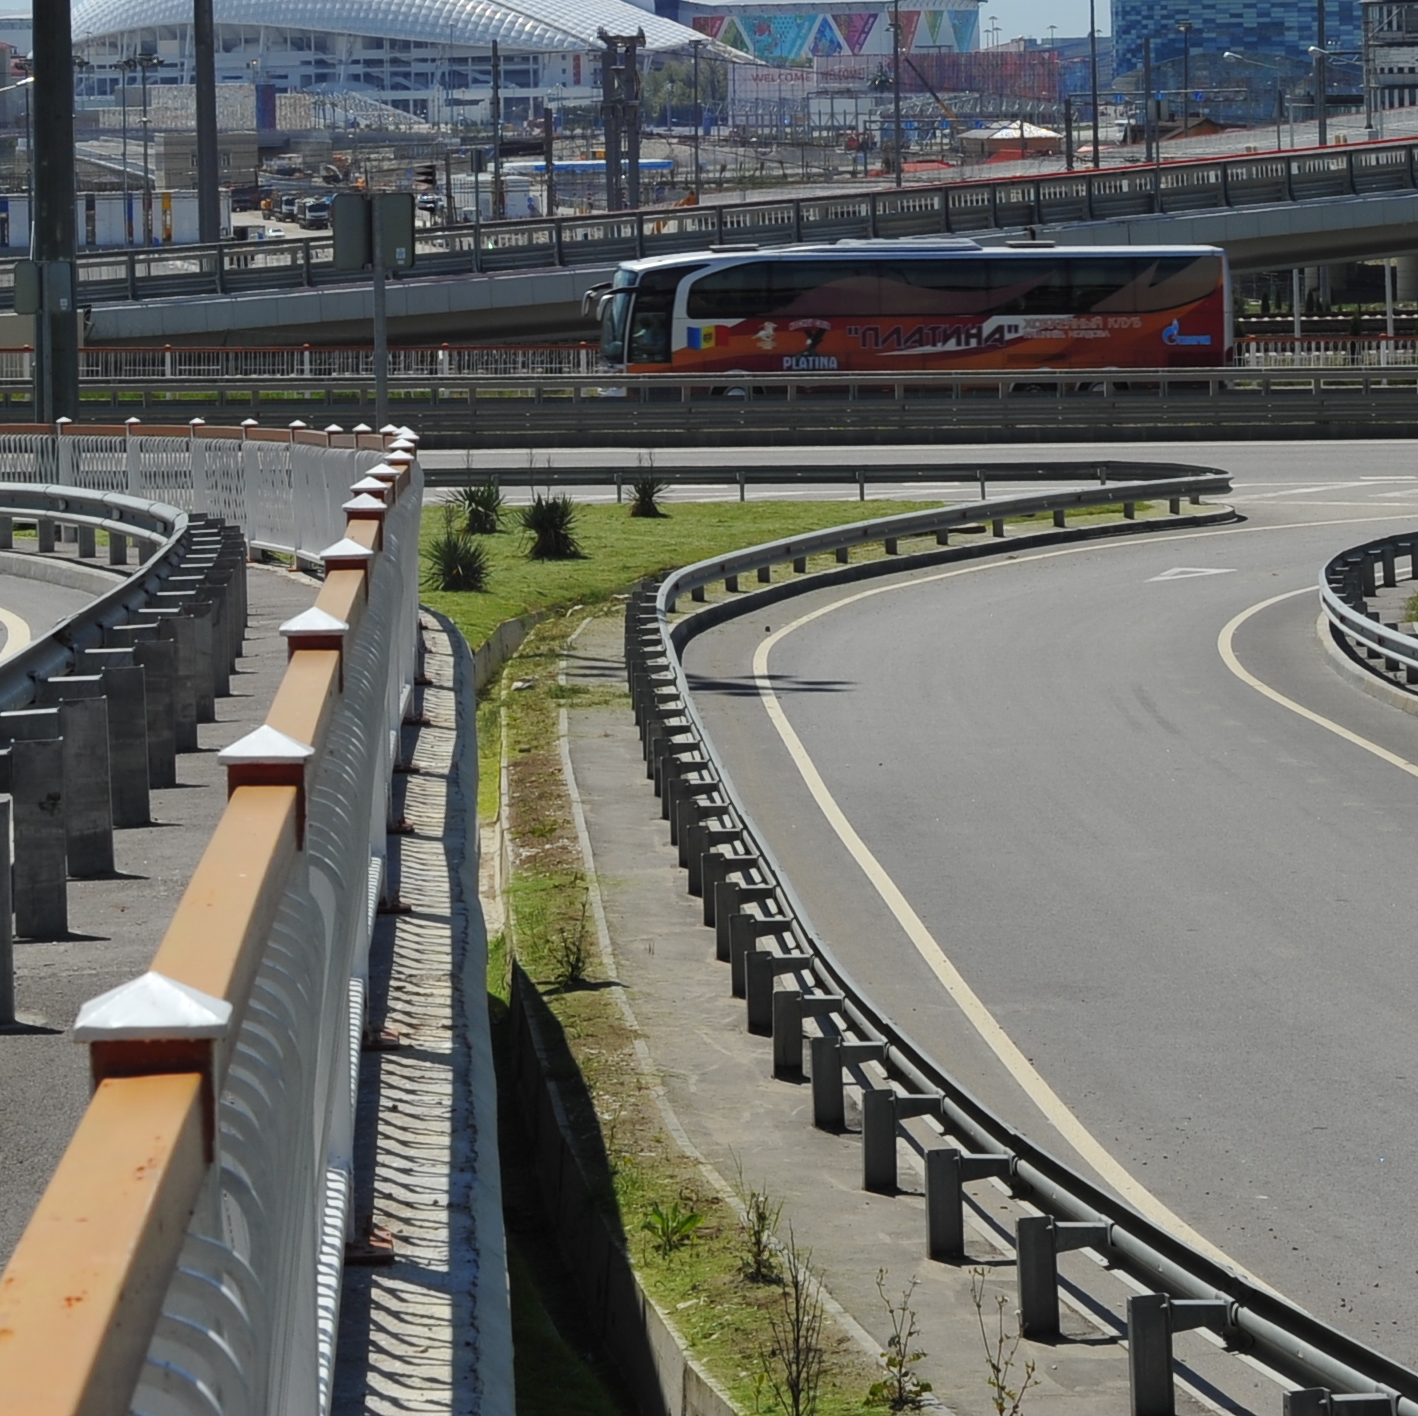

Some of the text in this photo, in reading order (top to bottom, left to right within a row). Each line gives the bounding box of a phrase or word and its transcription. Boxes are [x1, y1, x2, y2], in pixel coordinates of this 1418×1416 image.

[751, 72, 811, 83] WELCOME
[1107, 317, 1142, 329] КЛУБ
[846, 324, 1019, 349] "ПЛАТИНА"
[783, 356, 838, 370] PLATINA
